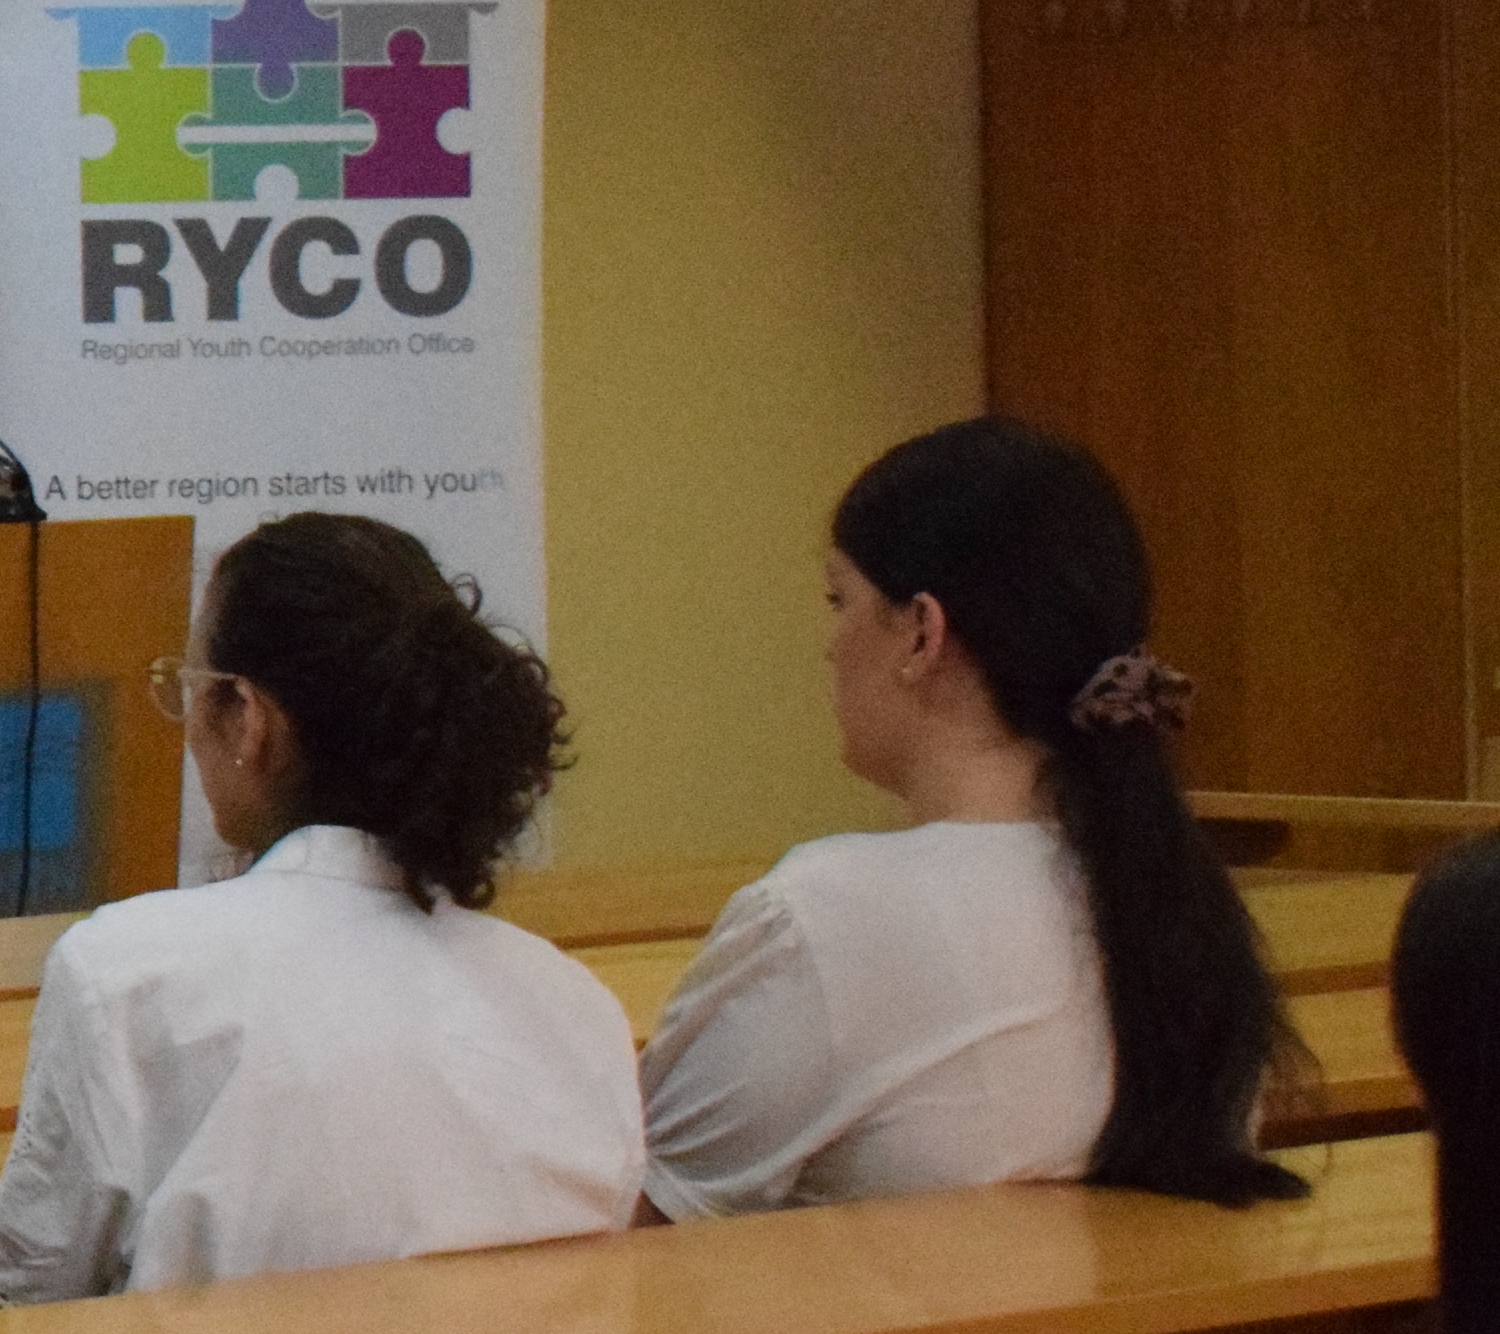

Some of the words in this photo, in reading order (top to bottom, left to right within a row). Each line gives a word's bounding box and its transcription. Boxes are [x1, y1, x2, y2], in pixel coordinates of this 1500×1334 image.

[80, 213, 473, 324] RYCO
[81, 338, 180, 365] Regional
[187, 337, 252, 359] Youth
[259, 334, 399, 360] Cooperation
[407, 332, 475, 354] Office
[44, 474, 67, 501] A
[77, 474, 159, 501] better
[167, 471, 258, 505] region
[267, 470, 346, 498] starts
[356, 467, 413, 496] with
